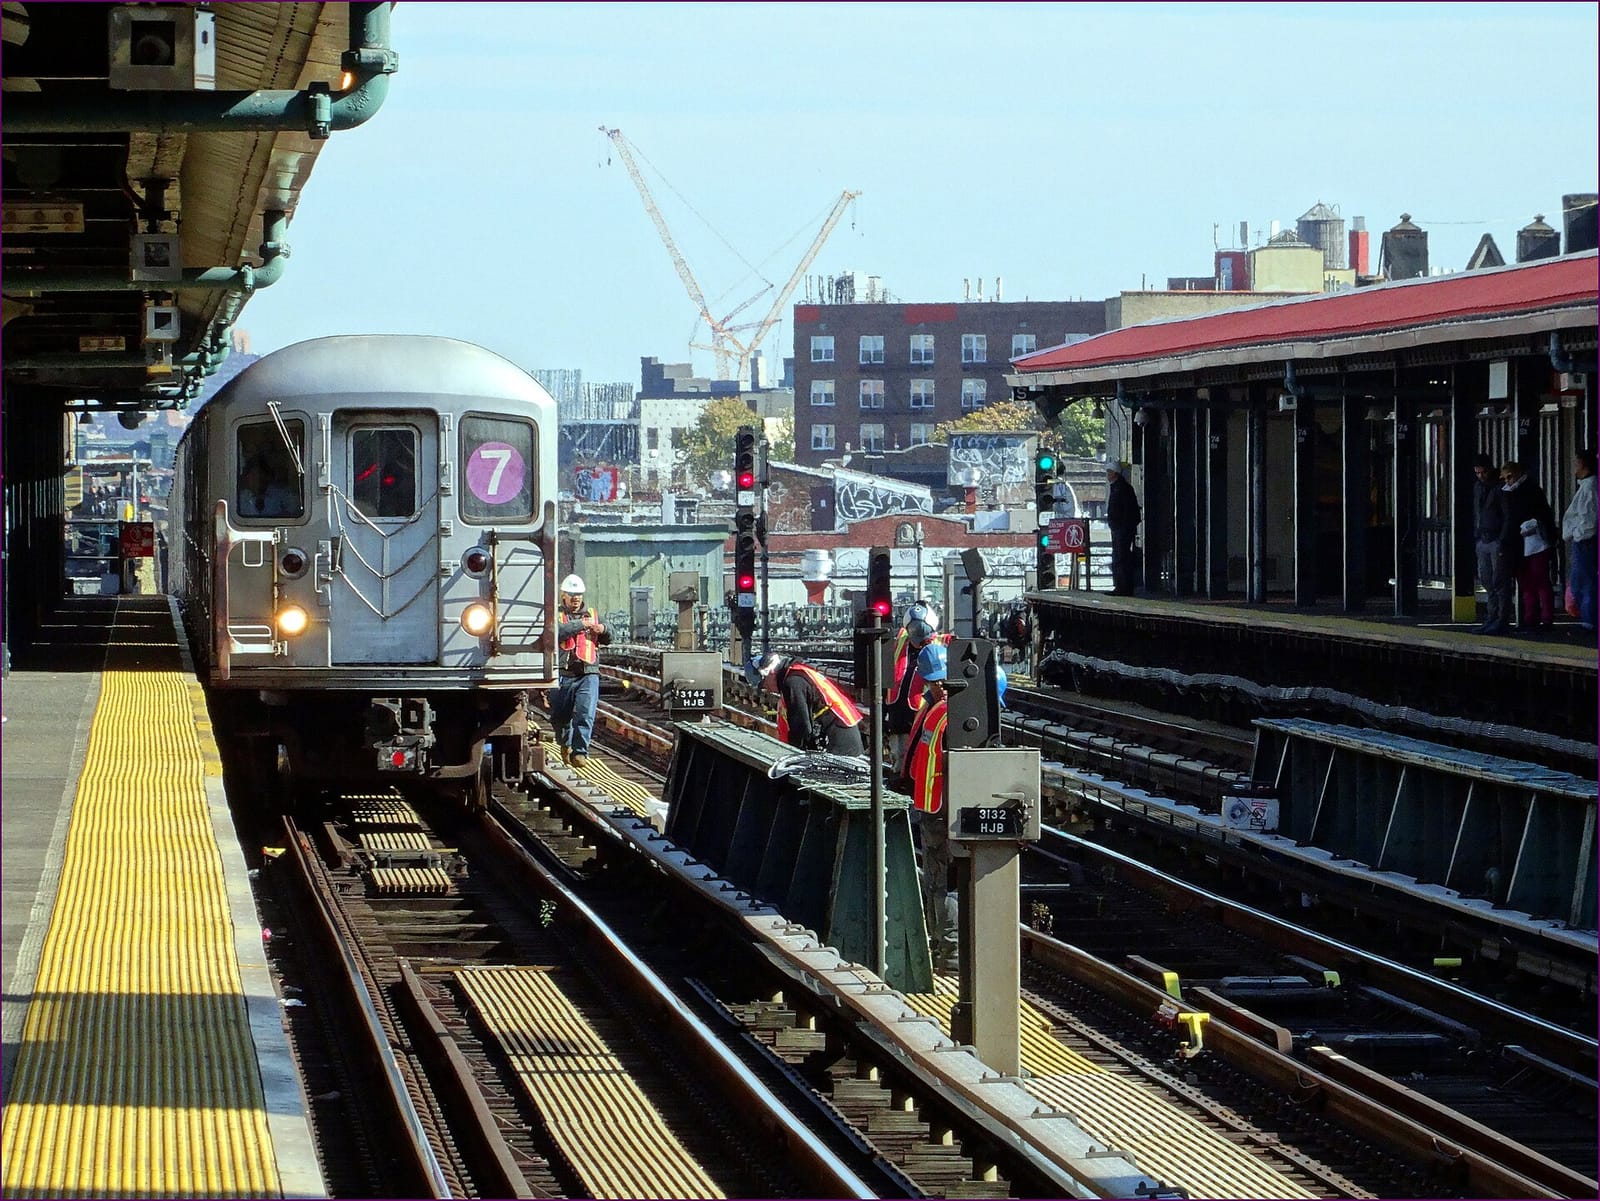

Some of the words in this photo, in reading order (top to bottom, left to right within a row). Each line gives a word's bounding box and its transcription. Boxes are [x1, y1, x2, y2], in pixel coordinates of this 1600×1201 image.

[1016, 386, 1027, 400] S
[480, 449, 512, 496] 7
[680, 690, 706, 698] 3144
[683, 699, 705, 707] HJB
[979, 808, 1007, 820] 3132
[980, 822, 1004, 833] HJB
